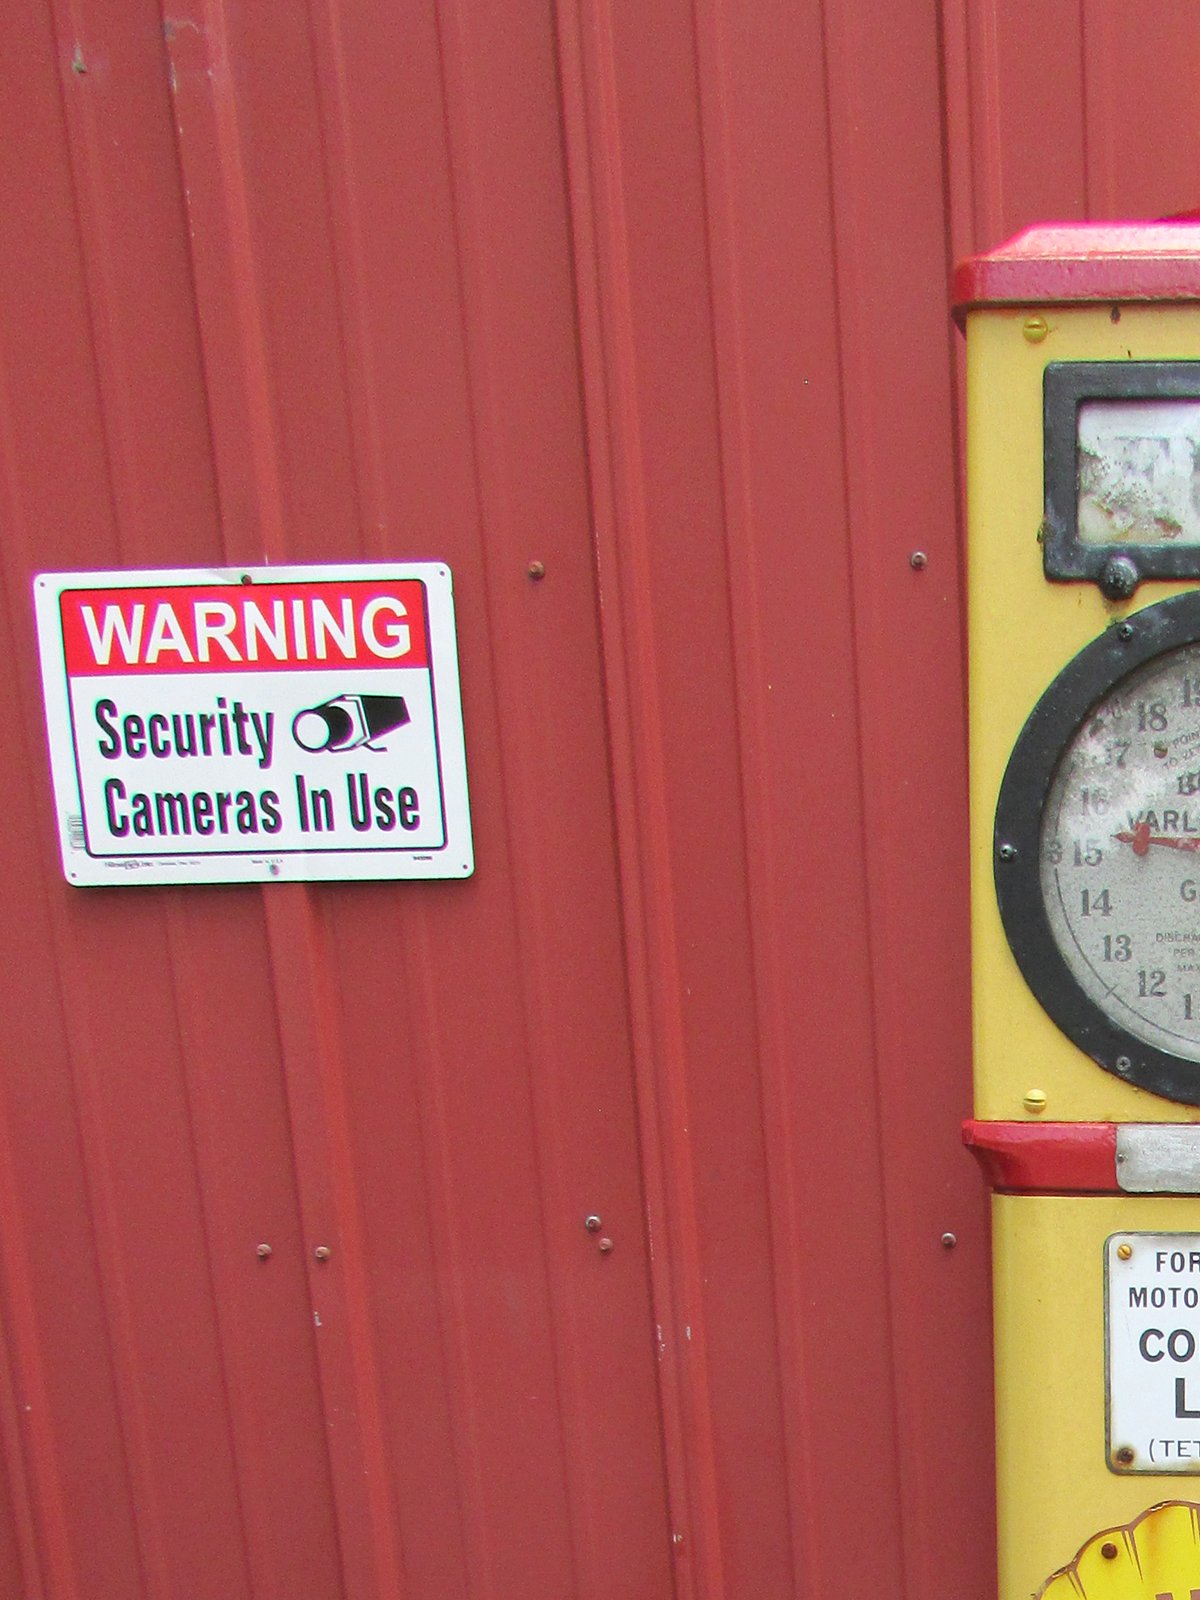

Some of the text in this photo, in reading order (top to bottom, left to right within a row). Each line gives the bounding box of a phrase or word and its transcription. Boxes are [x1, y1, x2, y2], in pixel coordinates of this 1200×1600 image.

[80, 596, 411, 665] WARNING
[1137, 702, 1168, 732] 18
[95, 697, 274, 769] Security
[104, 773, 420, 838] Cameras In Use
[1080, 787, 1110, 815] 16
[1073, 839, 1103, 867] 15
[1080, 888, 1113, 917] 14
[1102, 934, 1132, 962] 13
[1137, 970, 1166, 998] 12
